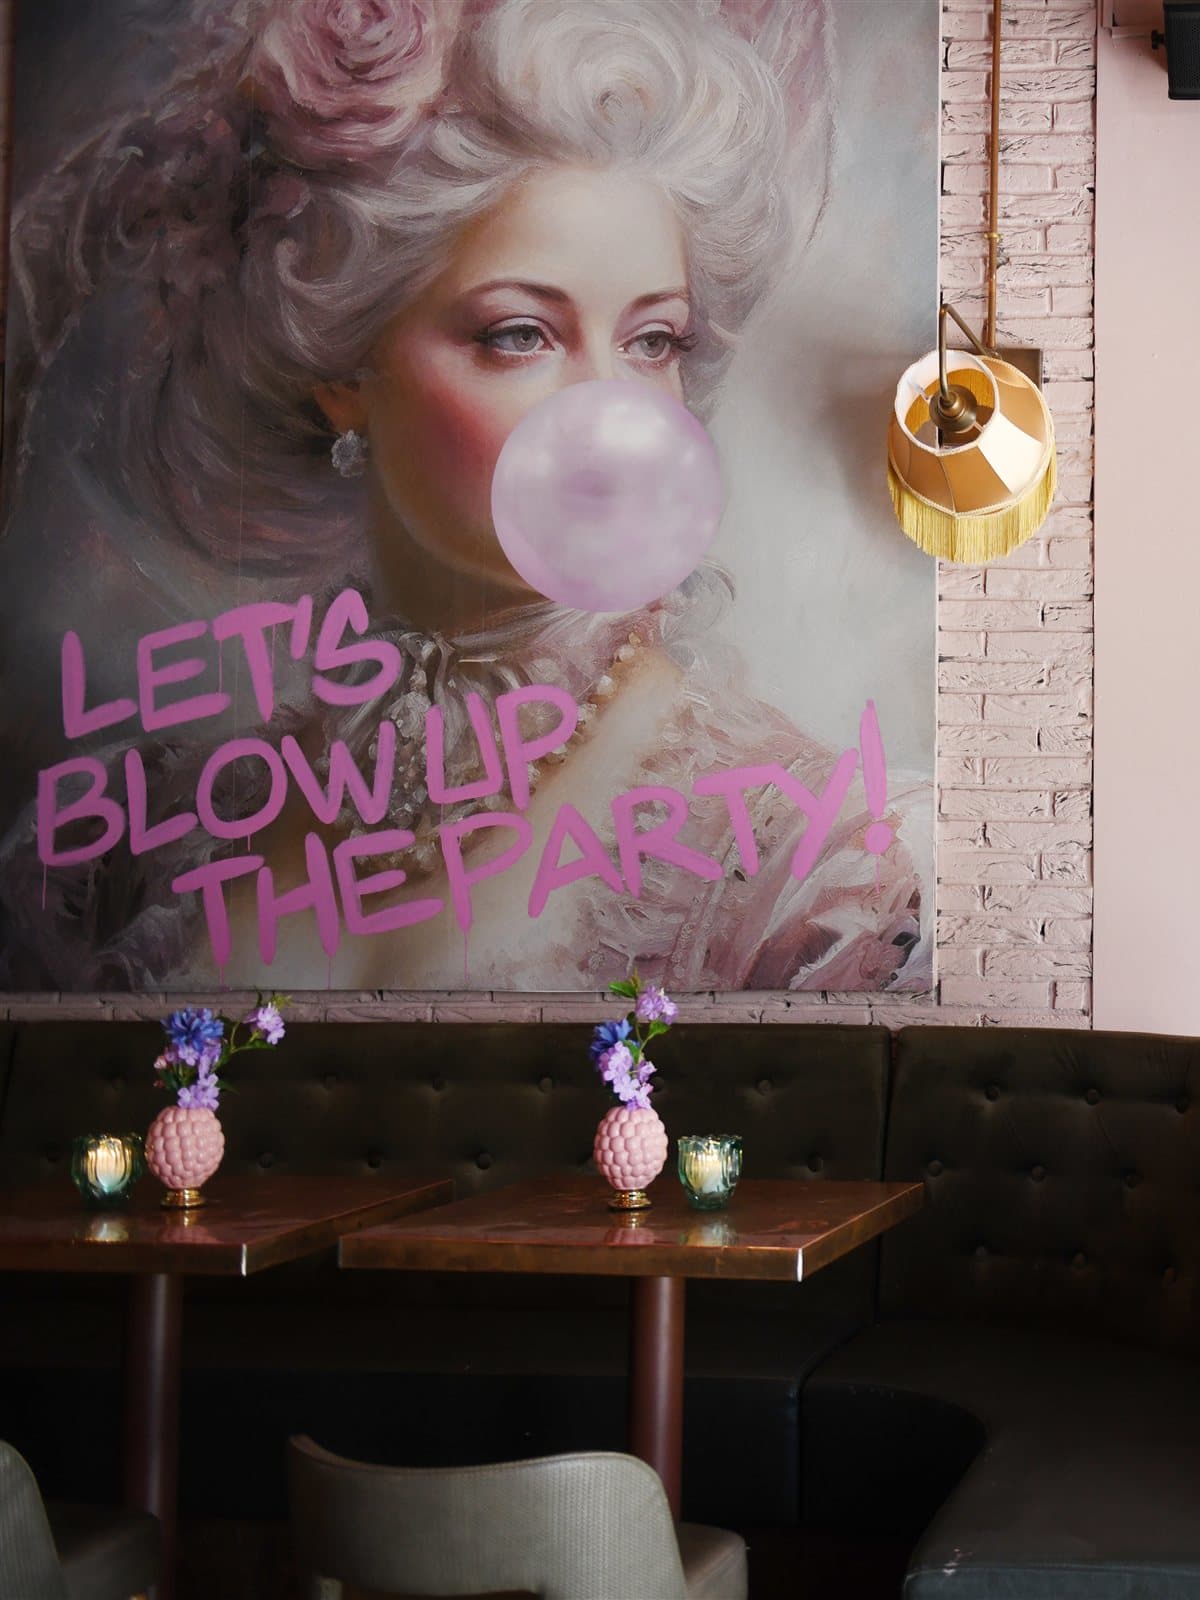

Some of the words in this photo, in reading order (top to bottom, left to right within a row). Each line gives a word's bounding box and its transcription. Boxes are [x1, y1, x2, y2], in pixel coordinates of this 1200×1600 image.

[61, 589, 402, 738] LET'S
[38, 721, 396, 866] BLOW
[425, 684, 579, 809] UP
[172, 830, 441, 966] THE
[440, 699, 889, 933] PARTY!
